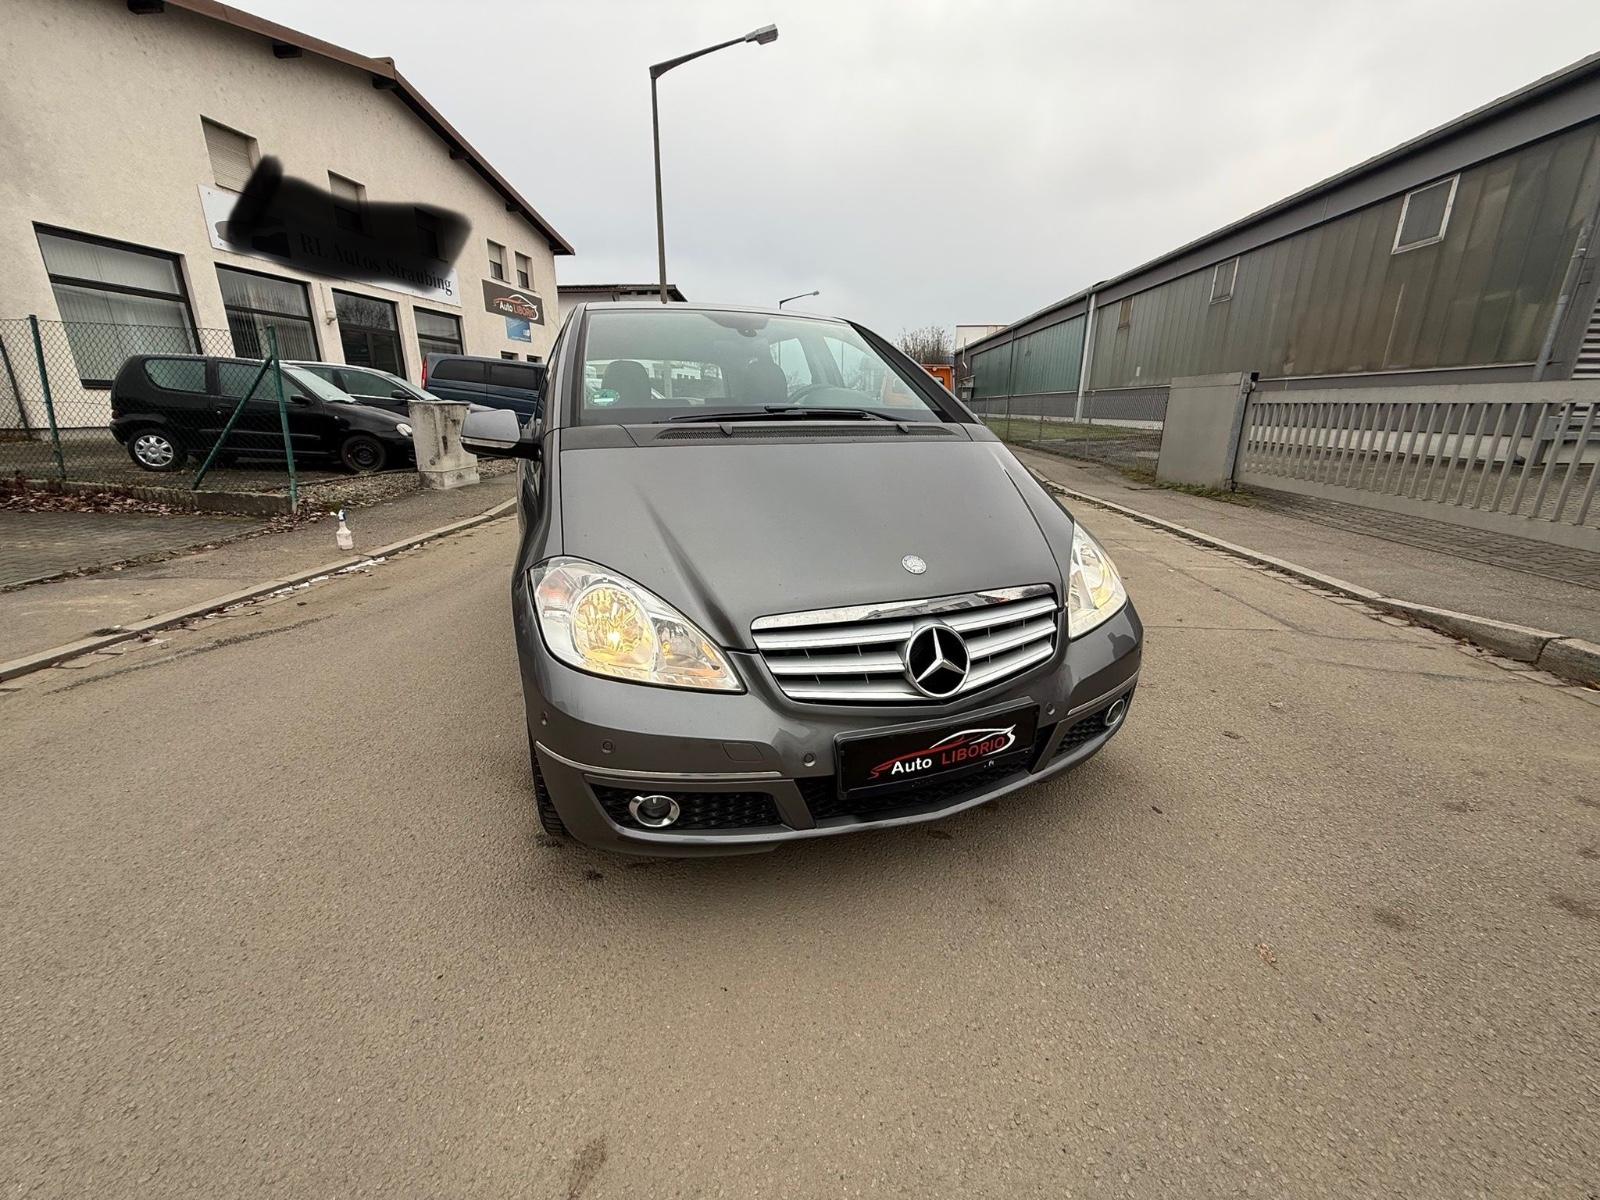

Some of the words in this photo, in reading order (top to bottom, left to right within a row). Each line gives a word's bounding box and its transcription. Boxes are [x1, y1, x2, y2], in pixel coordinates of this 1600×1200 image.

[334, 244, 381, 273] Autos
[386, 257, 453, 297] Straubing
[499, 301, 513, 313] Auto
[891, 758, 932, 775] Auto
[941, 736, 1006, 766] LIBORIO
